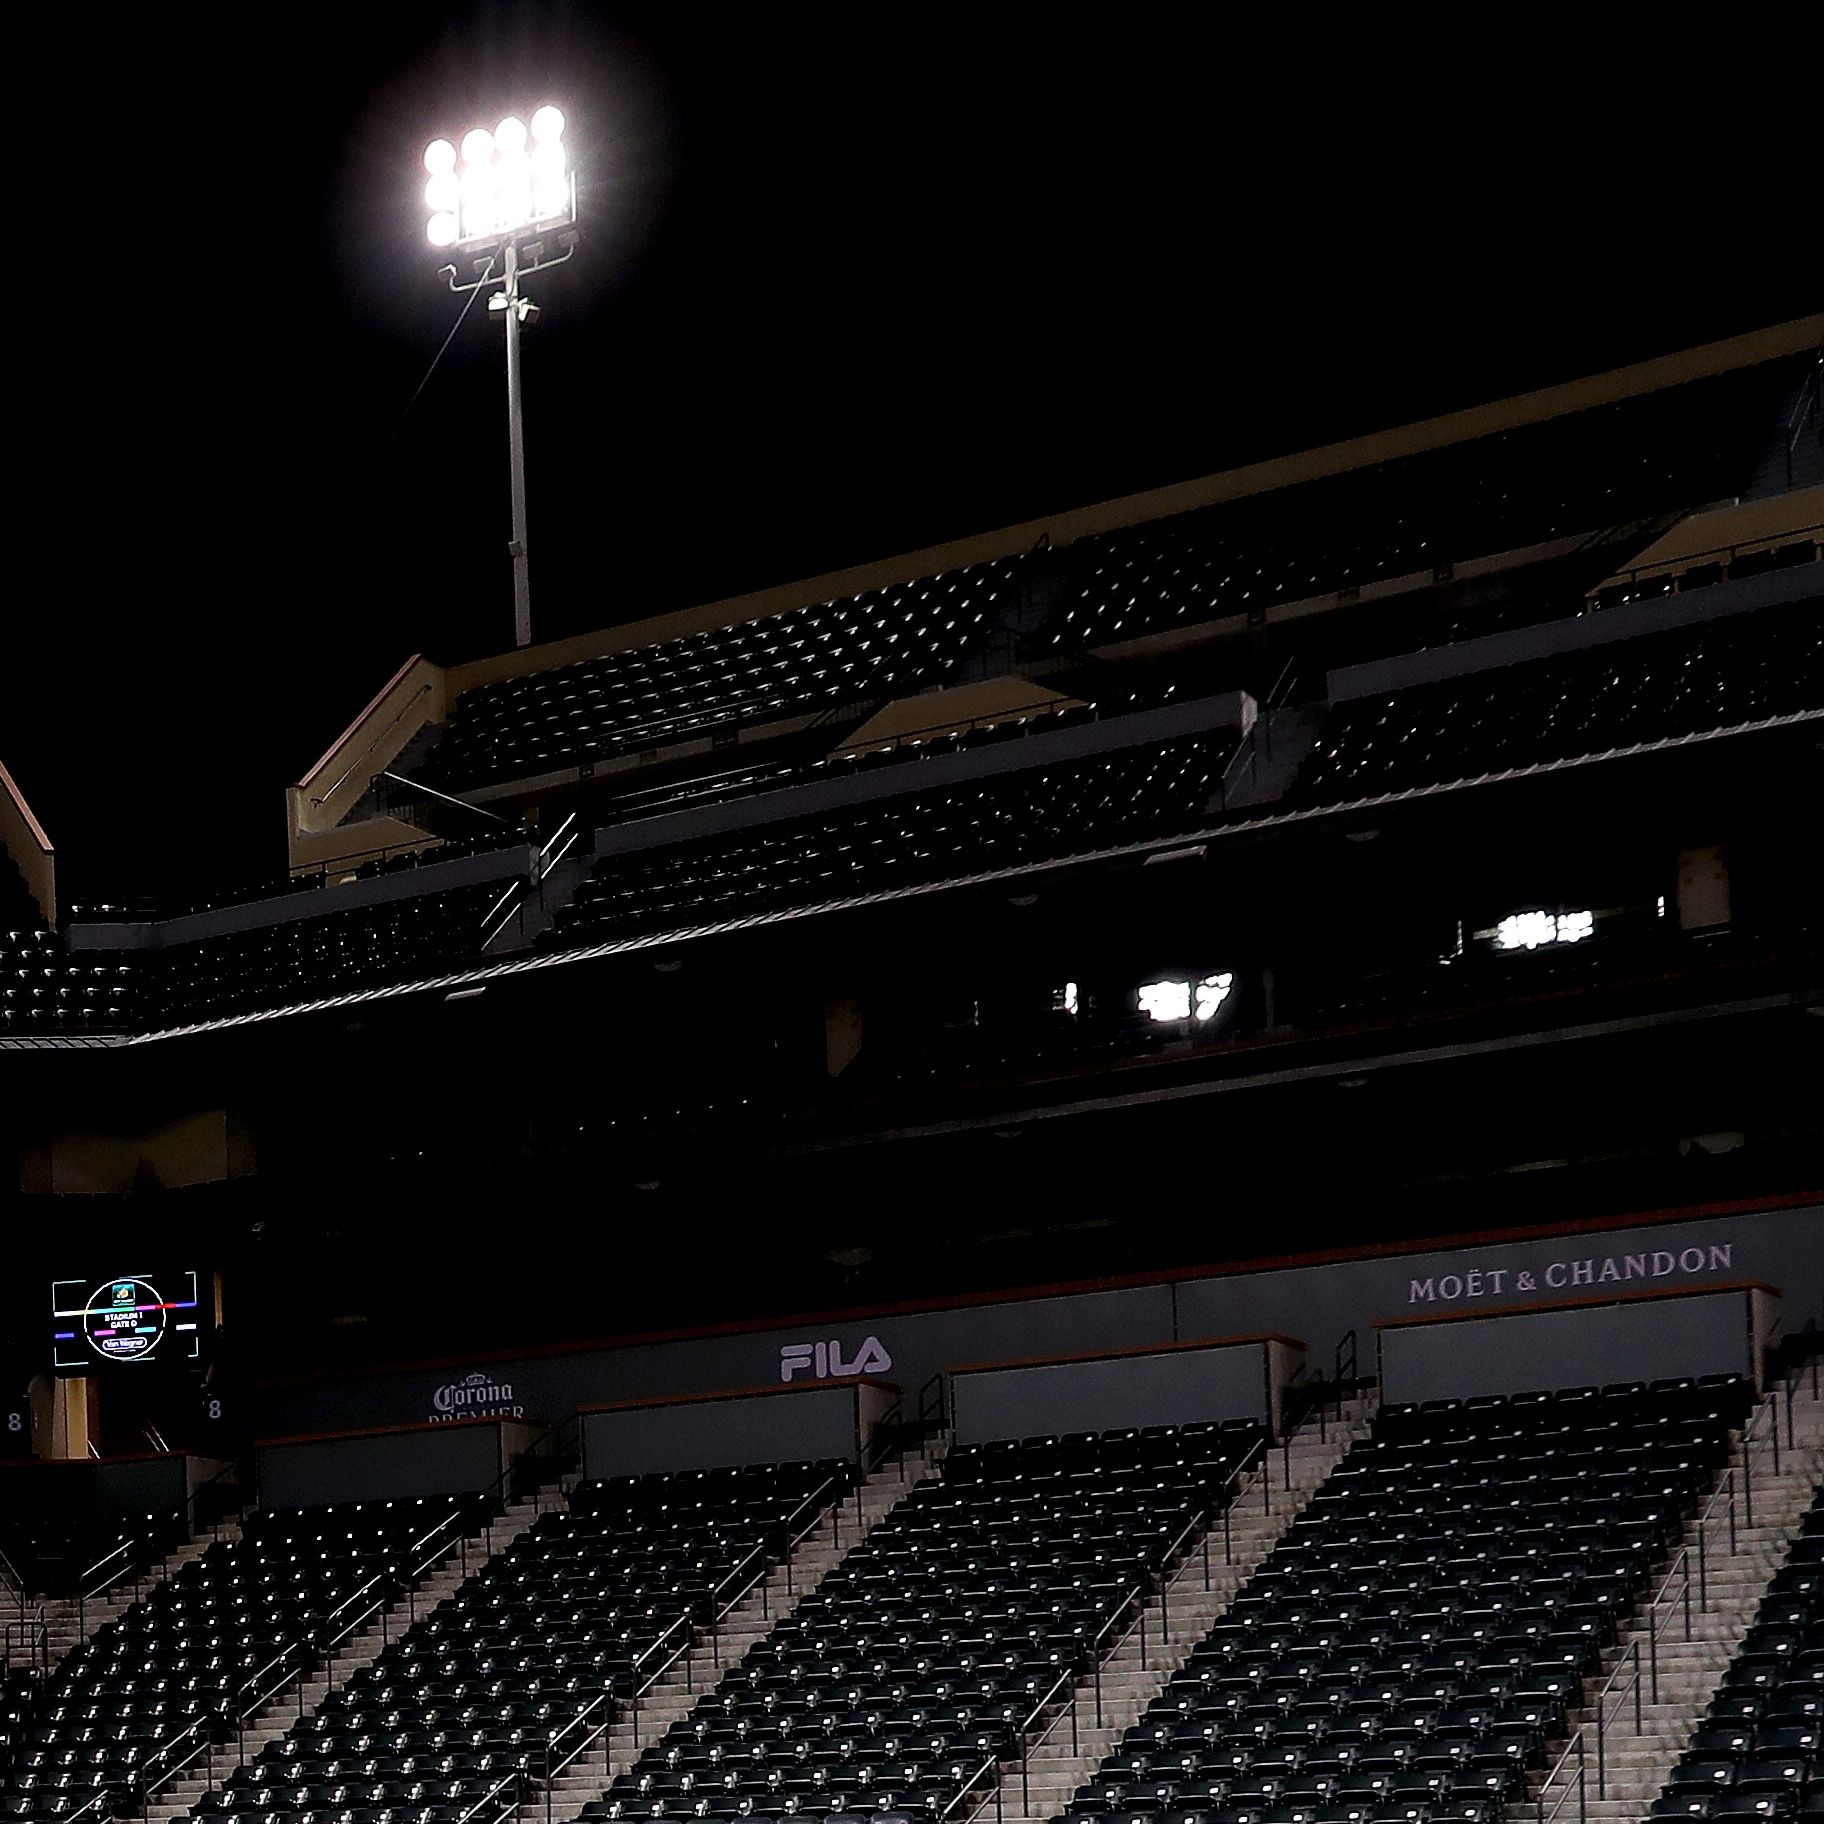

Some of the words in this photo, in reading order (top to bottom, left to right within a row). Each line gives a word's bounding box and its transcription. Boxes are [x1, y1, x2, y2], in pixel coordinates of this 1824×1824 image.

[1408, 1268, 1509, 1304] MOËT
[1516, 1271, 1537, 1292] &
[1545, 1244, 1734, 1289] CHANDON
[780, 1335, 893, 1382] FILA
[208, 1401, 222, 1418] 8
[433, 1384, 513, 1413] Corona
[8, 1413, 22, 1431] 8
